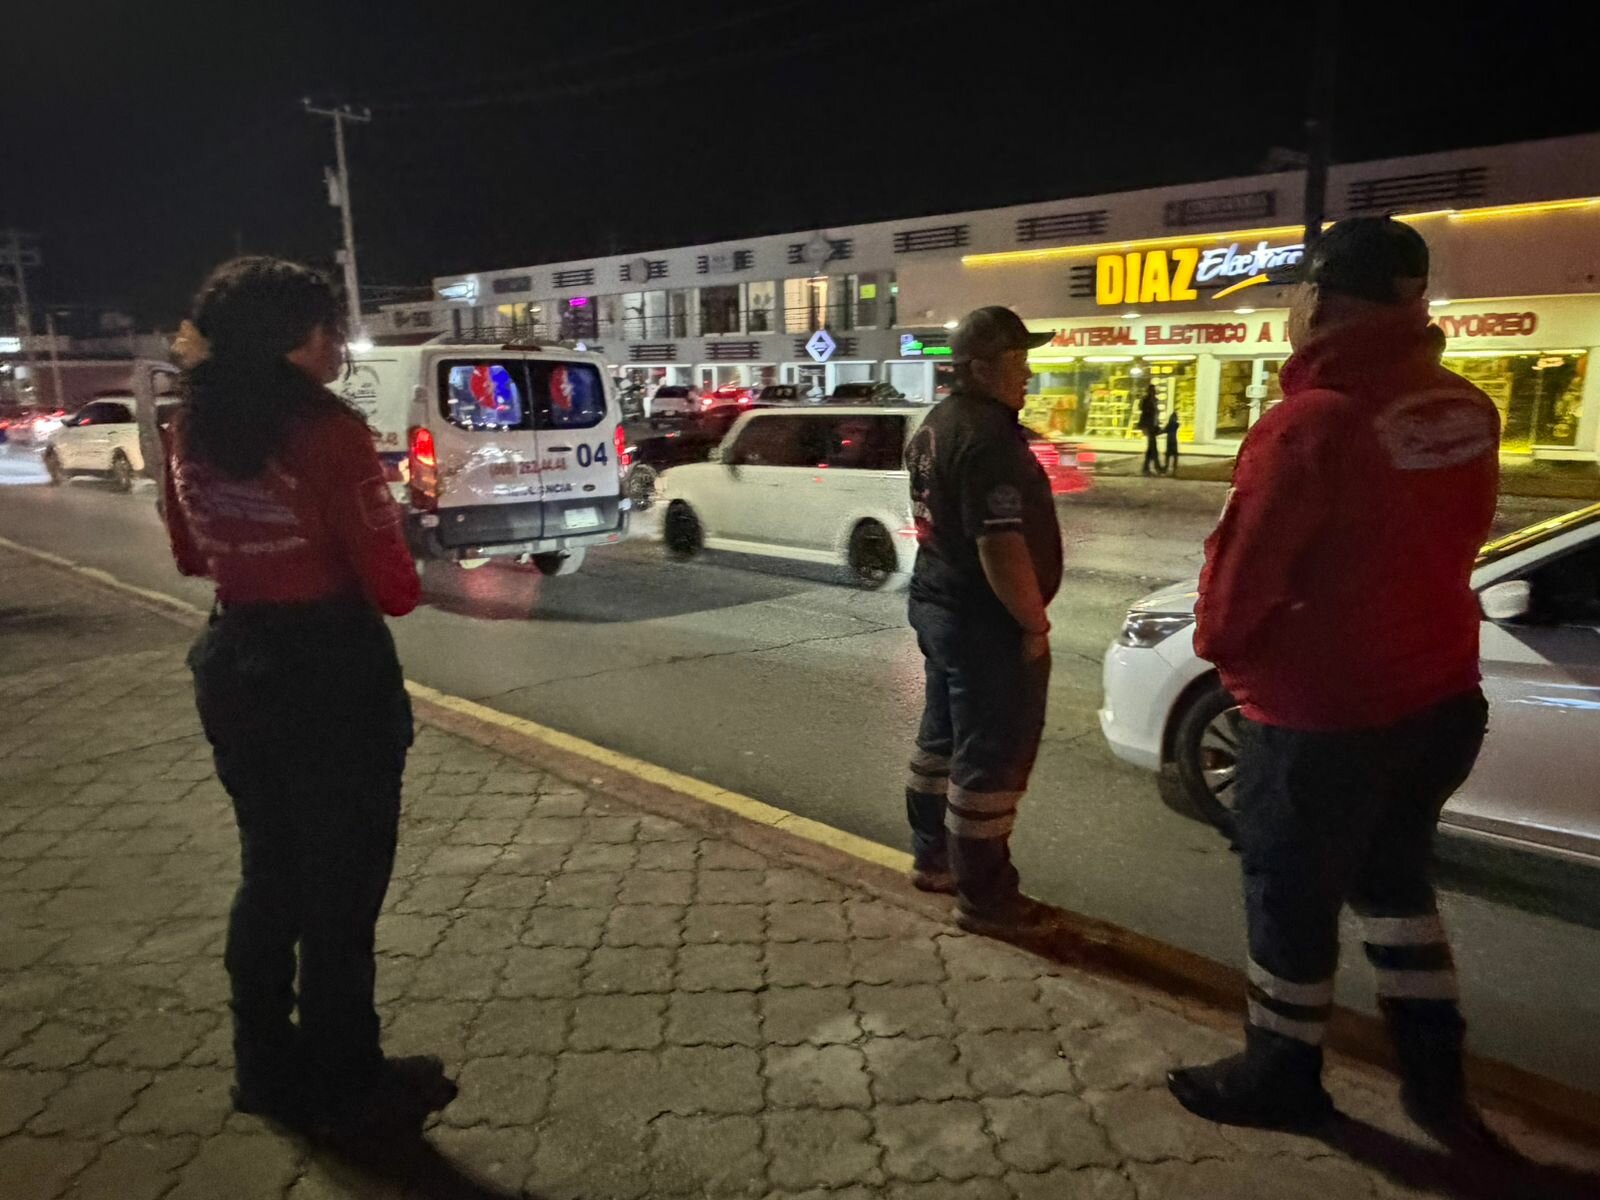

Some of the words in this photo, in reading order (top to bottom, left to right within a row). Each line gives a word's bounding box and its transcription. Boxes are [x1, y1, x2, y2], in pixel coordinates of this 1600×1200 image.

[1096, 248, 1198, 305] DIAZ
[1050, 326, 1137, 347] MATERIAL
[1144, 322, 1247, 346] ELECTRICO
[1257, 322, 1272, 343] A
[576, 442, 608, 468] 04
